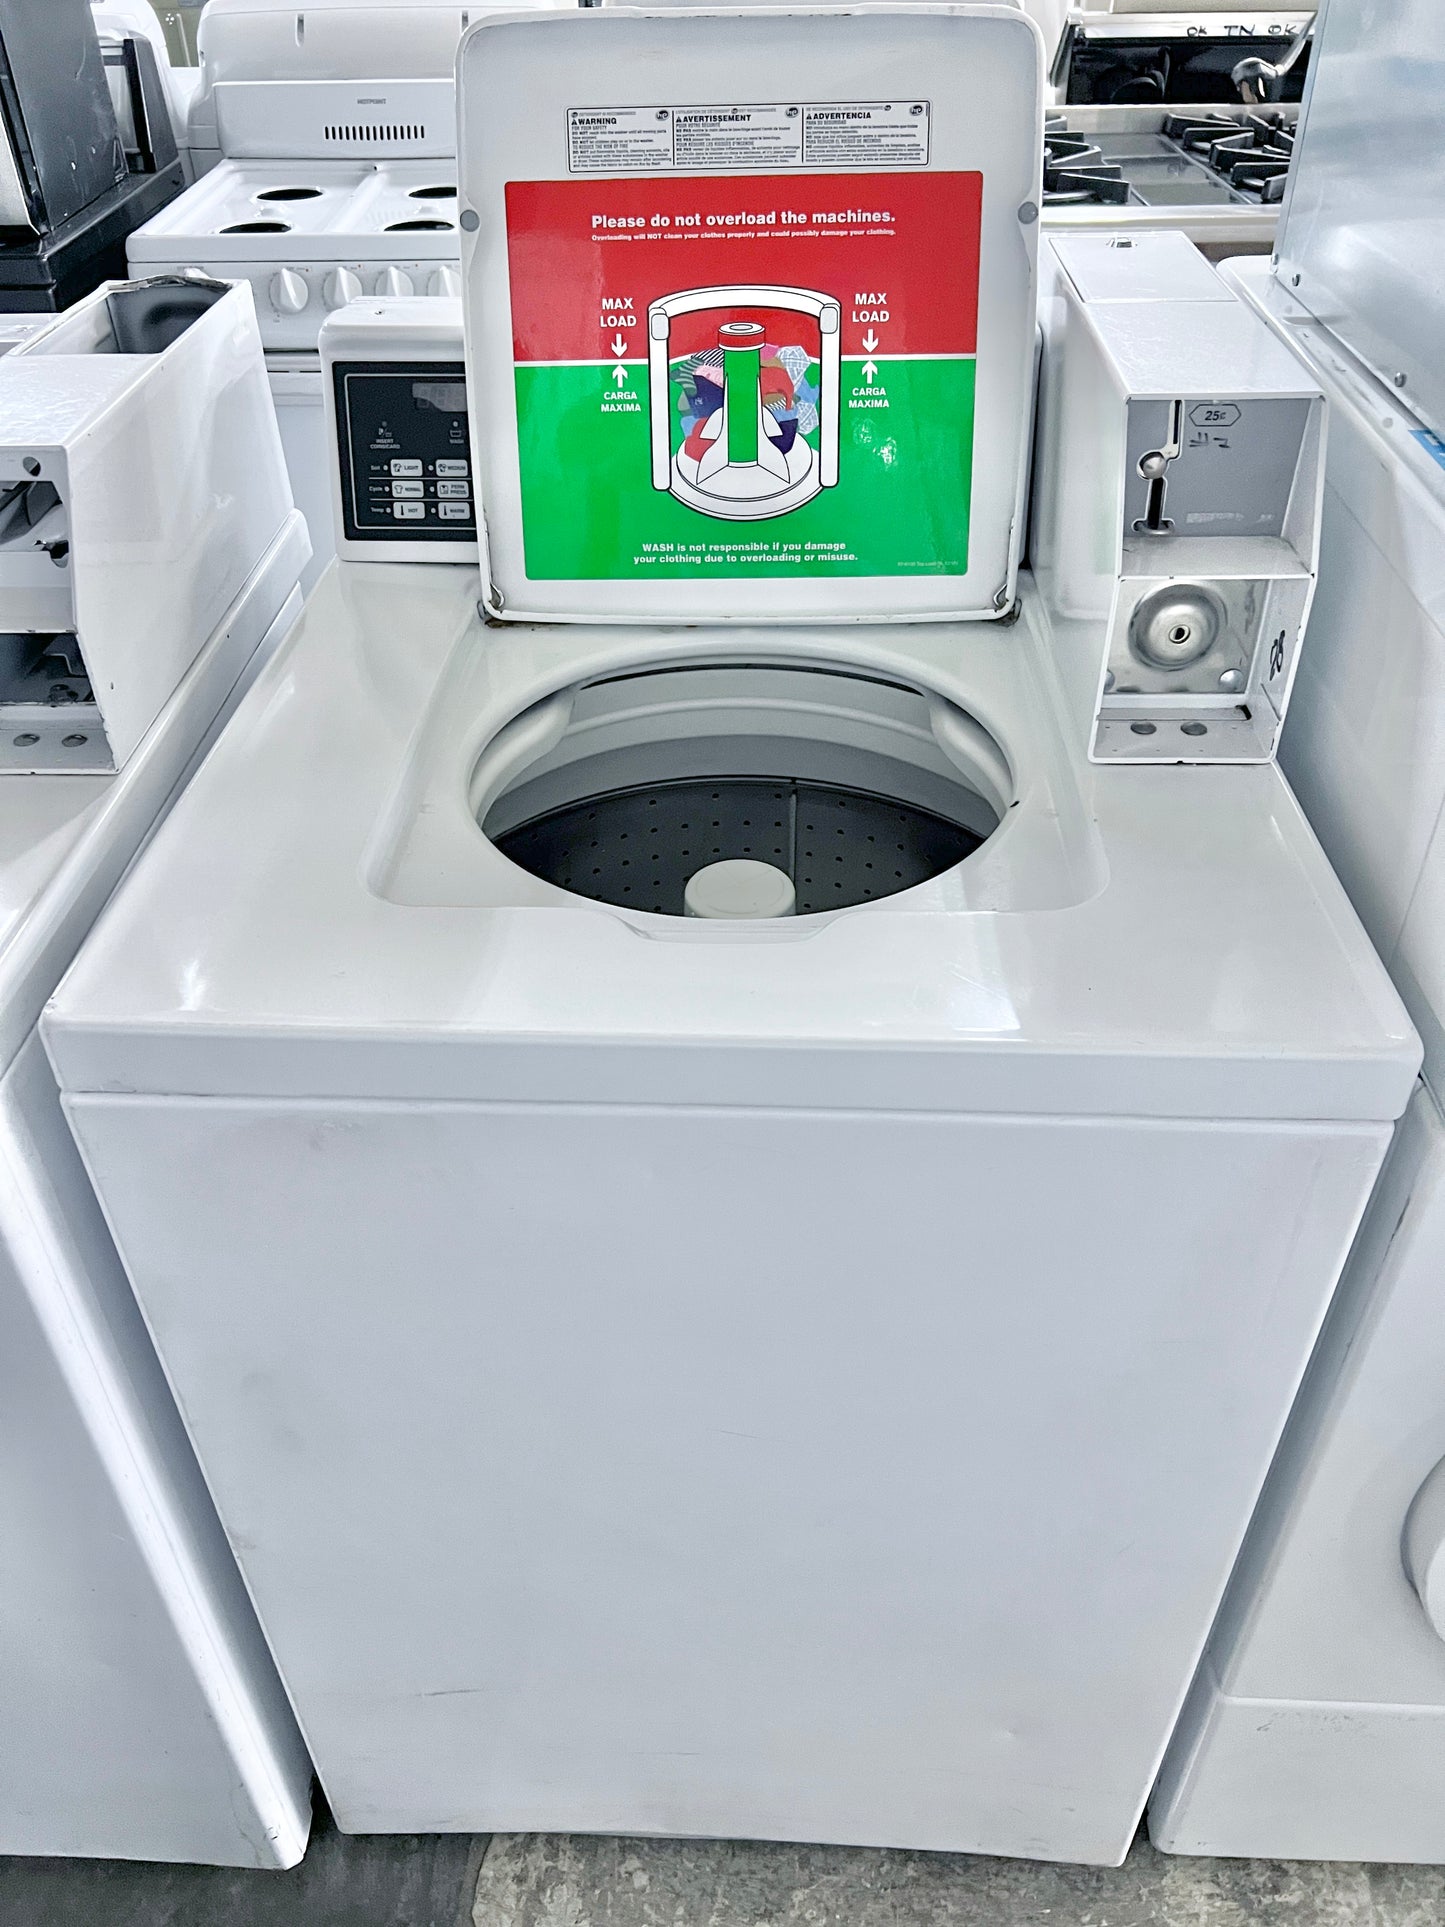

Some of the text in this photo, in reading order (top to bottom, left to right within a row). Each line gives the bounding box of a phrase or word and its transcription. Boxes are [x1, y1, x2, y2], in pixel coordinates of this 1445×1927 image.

[577, 117, 617, 125] WARNING
[683, 113, 751, 122] AVERTISSEMENT
[812, 112, 871, 120] ADVERTENCIA
[592, 209, 895, 228] Please do not overload the machines.
[590, 233, 632, 241] Overloading
[632, 232, 646, 240] will
[646, 232, 662, 240] NOT
[683, 232, 699, 240] your
[699, 231, 726, 239] clothes
[726, 230, 755, 239] properly
[769, 229, 790, 237] could
[790, 229, 820, 238] possibly
[820, 229, 848, 237] damage
[848, 229, 865, 237] your
[602, 298, 633, 310] MAX
[855, 293, 887, 305] MAX
[600, 315, 637, 328] LOAD
[852, 310, 890, 323] LOAD
[603, 391, 637, 401] CARGA
[852, 387, 886, 396] CARGA
[600, 402, 641, 412] MAXIMA
[848, 398, 890, 408] MAXIMA
[1205, 410, 1227, 421] 25¢
[642, 541, 845, 554] WASH is not responsible if you damage
[633, 556, 656, 564] your
[659, 554, 700, 563] clothing
[704, 554, 723, 562] due
[740, 553, 800, 562] overloading
[818, 552, 857, 560] misuse.
